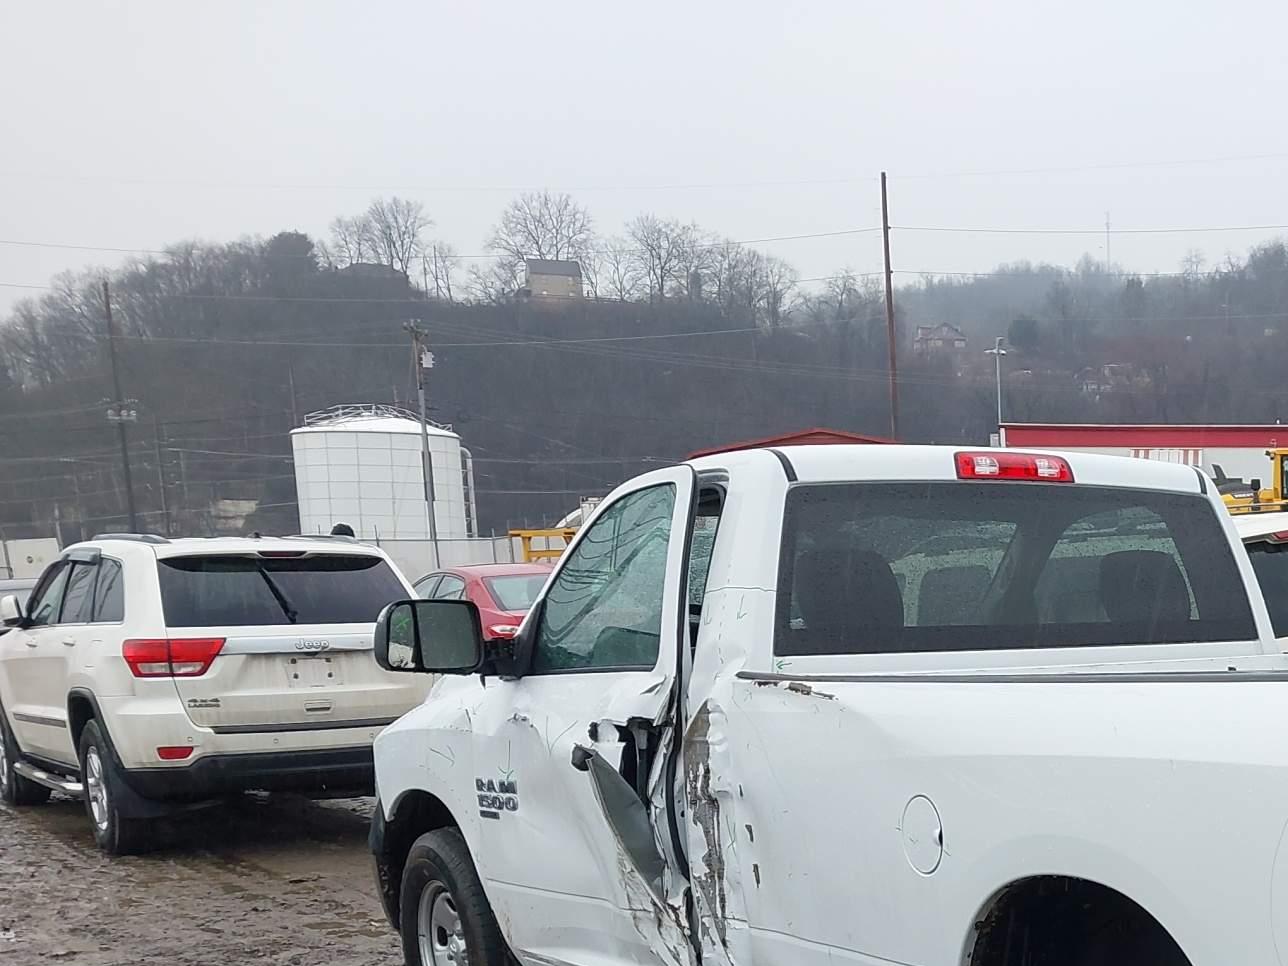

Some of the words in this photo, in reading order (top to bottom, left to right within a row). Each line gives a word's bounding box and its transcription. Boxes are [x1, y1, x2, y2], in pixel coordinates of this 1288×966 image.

[295, 638, 330, 650] Jeep
[475, 778, 518, 795] RAM
[477, 794, 519, 812] 1500
